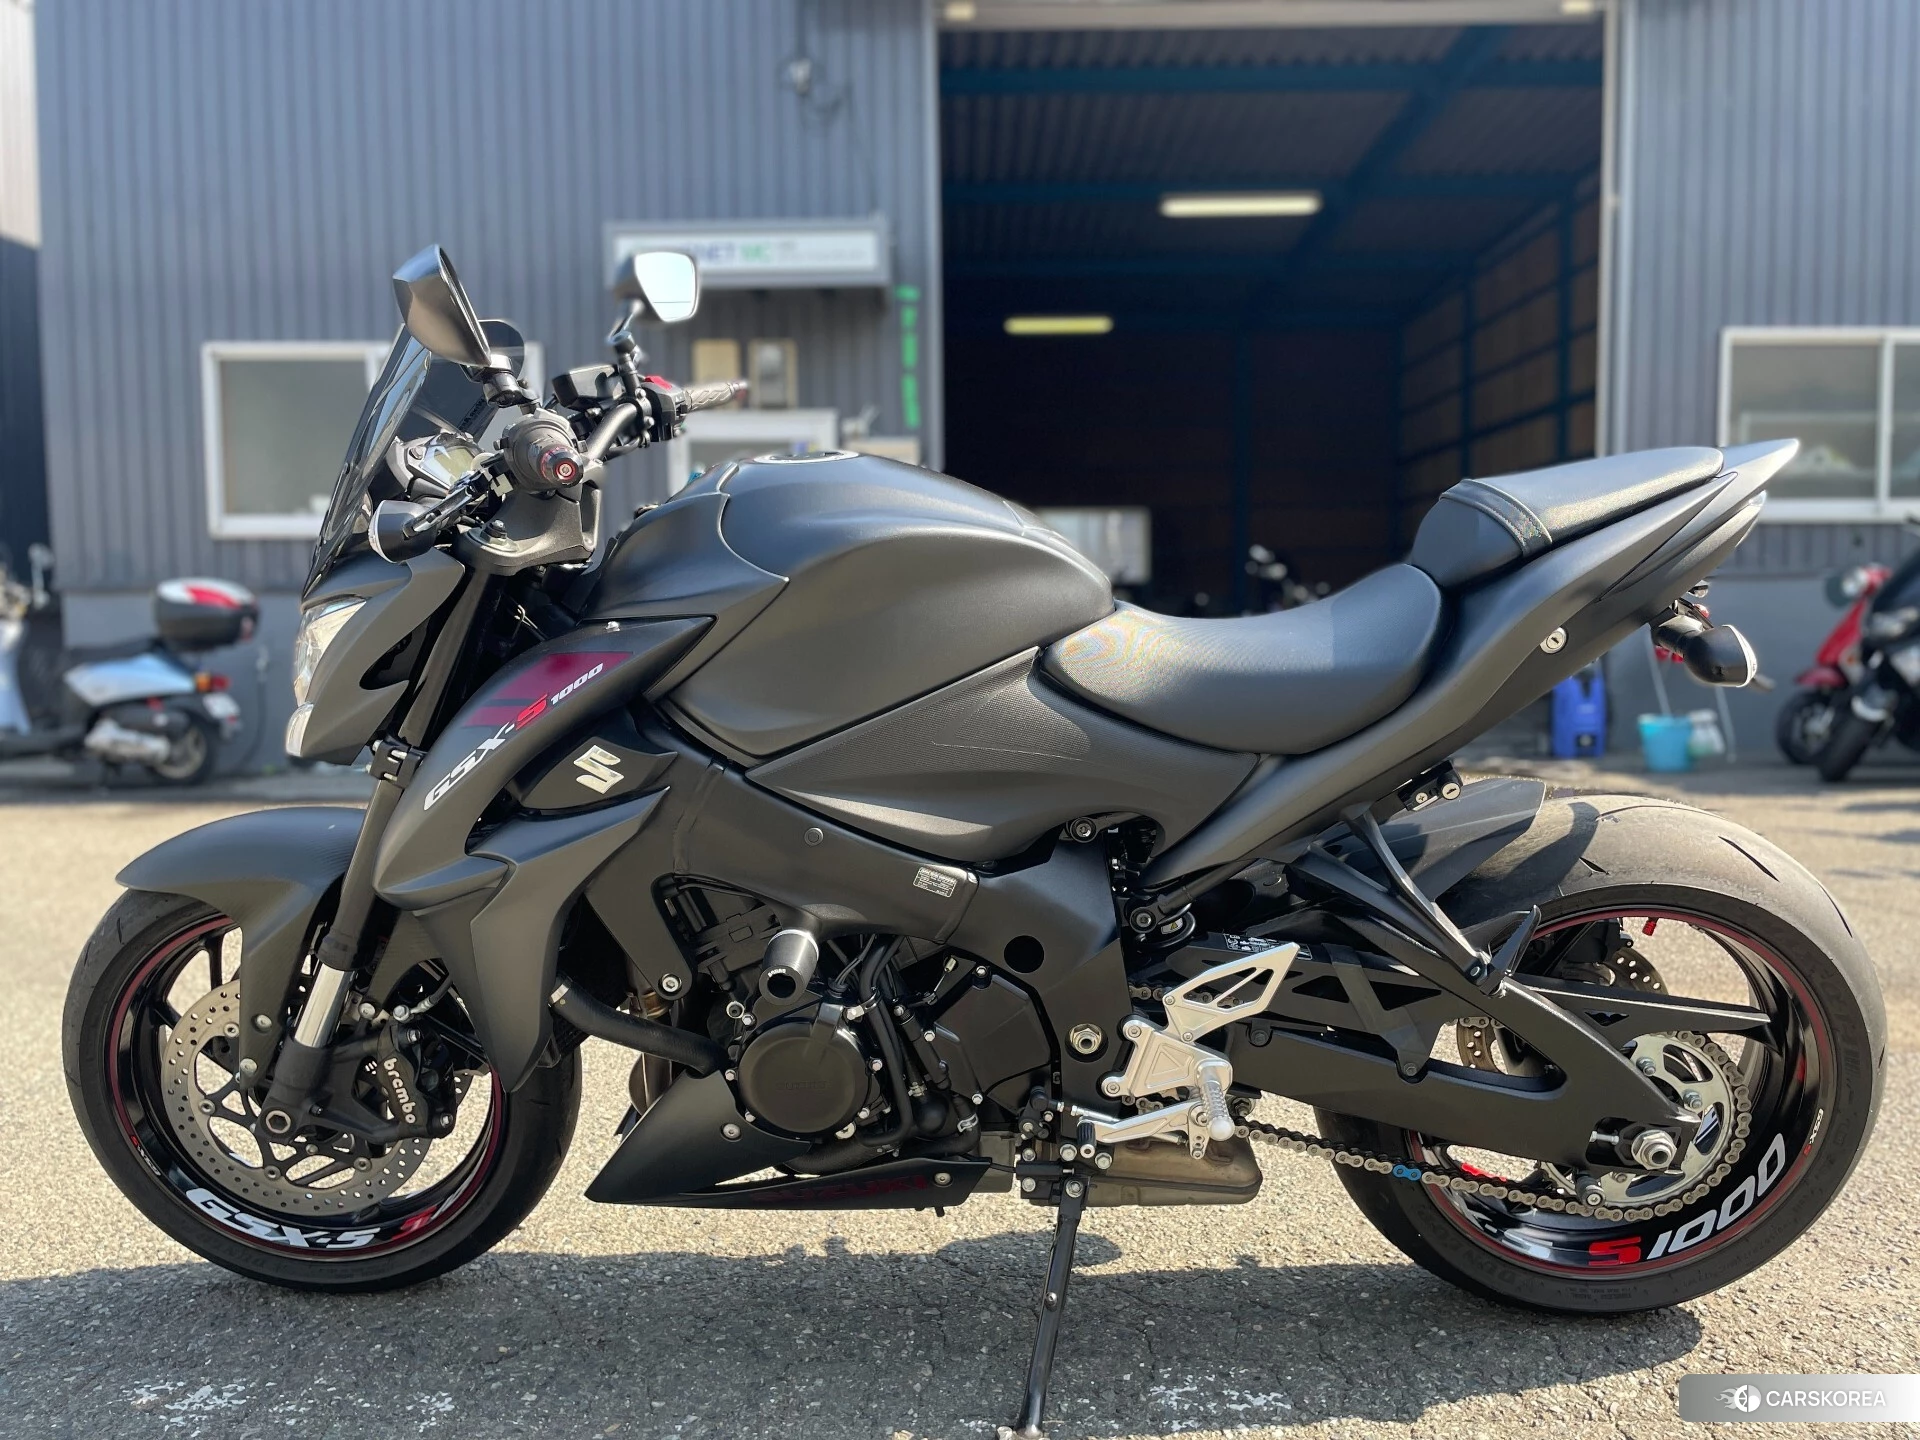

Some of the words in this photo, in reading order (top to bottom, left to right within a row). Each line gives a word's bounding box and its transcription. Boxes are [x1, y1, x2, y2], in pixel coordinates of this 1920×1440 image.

[424, 693, 548, 811] GSX-S
[550, 663, 604, 706] 1000
[383, 1057, 416, 1124] brembo
[186, 1188, 381, 1249] GSX-S
